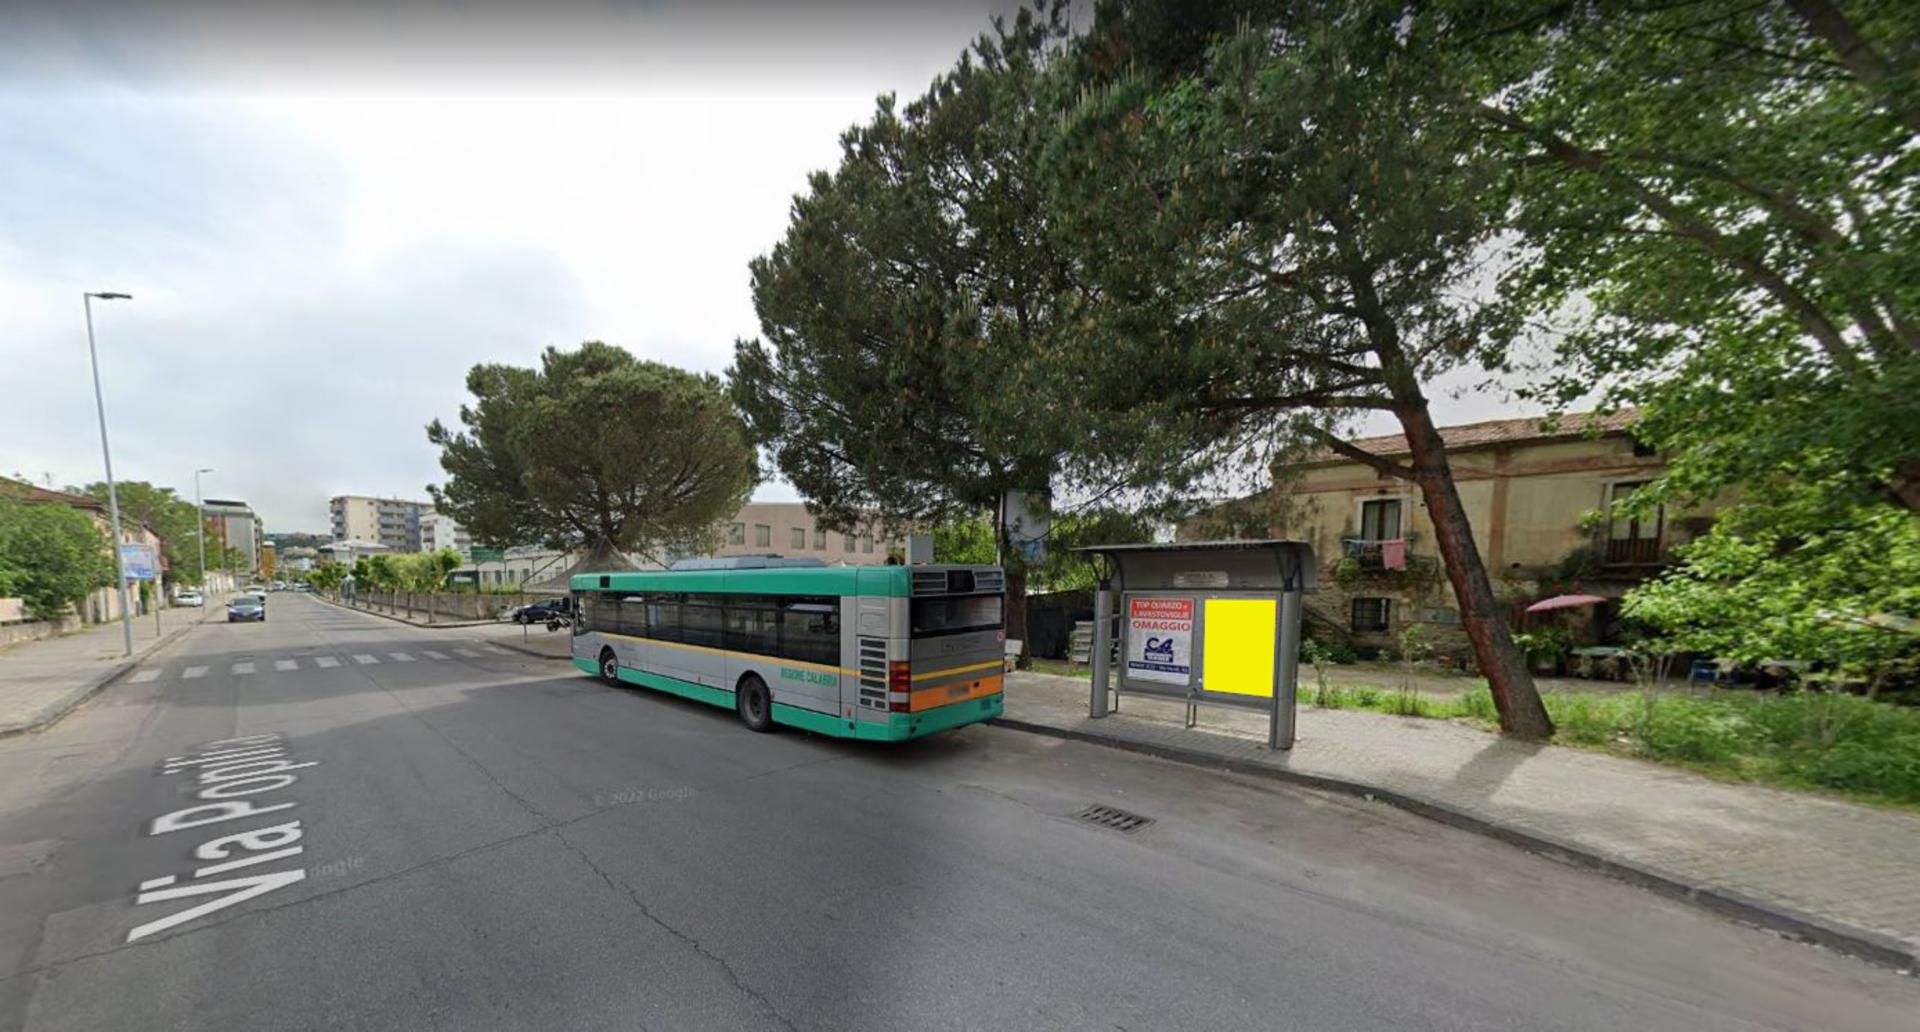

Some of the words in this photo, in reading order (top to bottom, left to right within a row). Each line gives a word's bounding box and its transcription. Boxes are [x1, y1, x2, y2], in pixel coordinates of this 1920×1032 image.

[1136, 601, 1150, 609] TOP
[1132, 620, 1191, 632] OMAGGIO
[807, 669, 838, 689] CALABRIA
